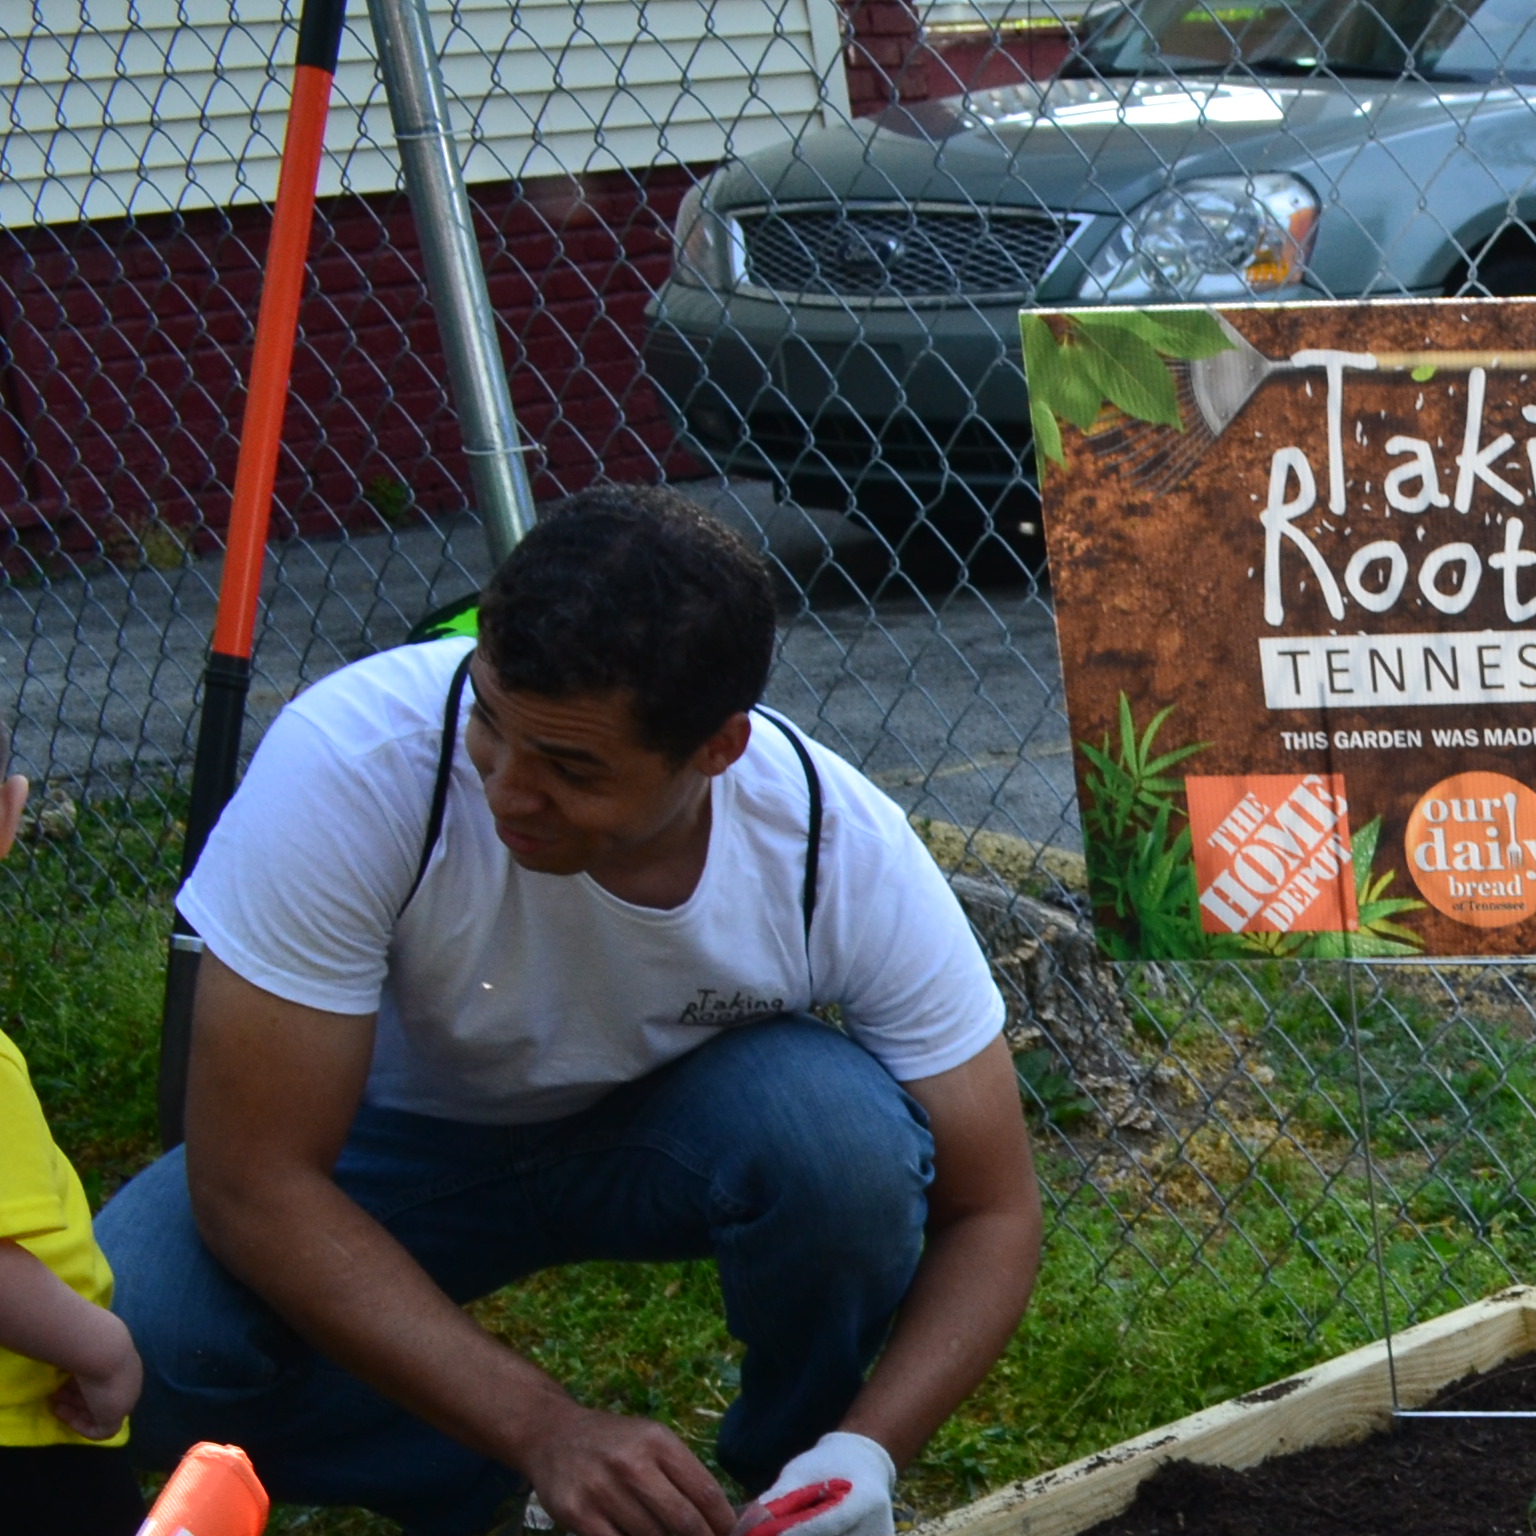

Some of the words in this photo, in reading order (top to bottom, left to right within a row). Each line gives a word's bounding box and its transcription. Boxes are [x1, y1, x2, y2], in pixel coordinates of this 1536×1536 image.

[1281, 732, 1328, 750] THIS
[1334, 730, 1422, 749] GARDEN
[1432, 729, 1479, 748] WAS
[1422, 798, 1501, 823] our
[1206, 791, 1271, 857] THE
[1199, 773, 1349, 933] HOME
[1260, 832, 1353, 933] DEPOT
[1448, 874, 1524, 898] bread
[1452, 900, 1466, 912] of
[1466, 900, 1527, 912] Tennessee
